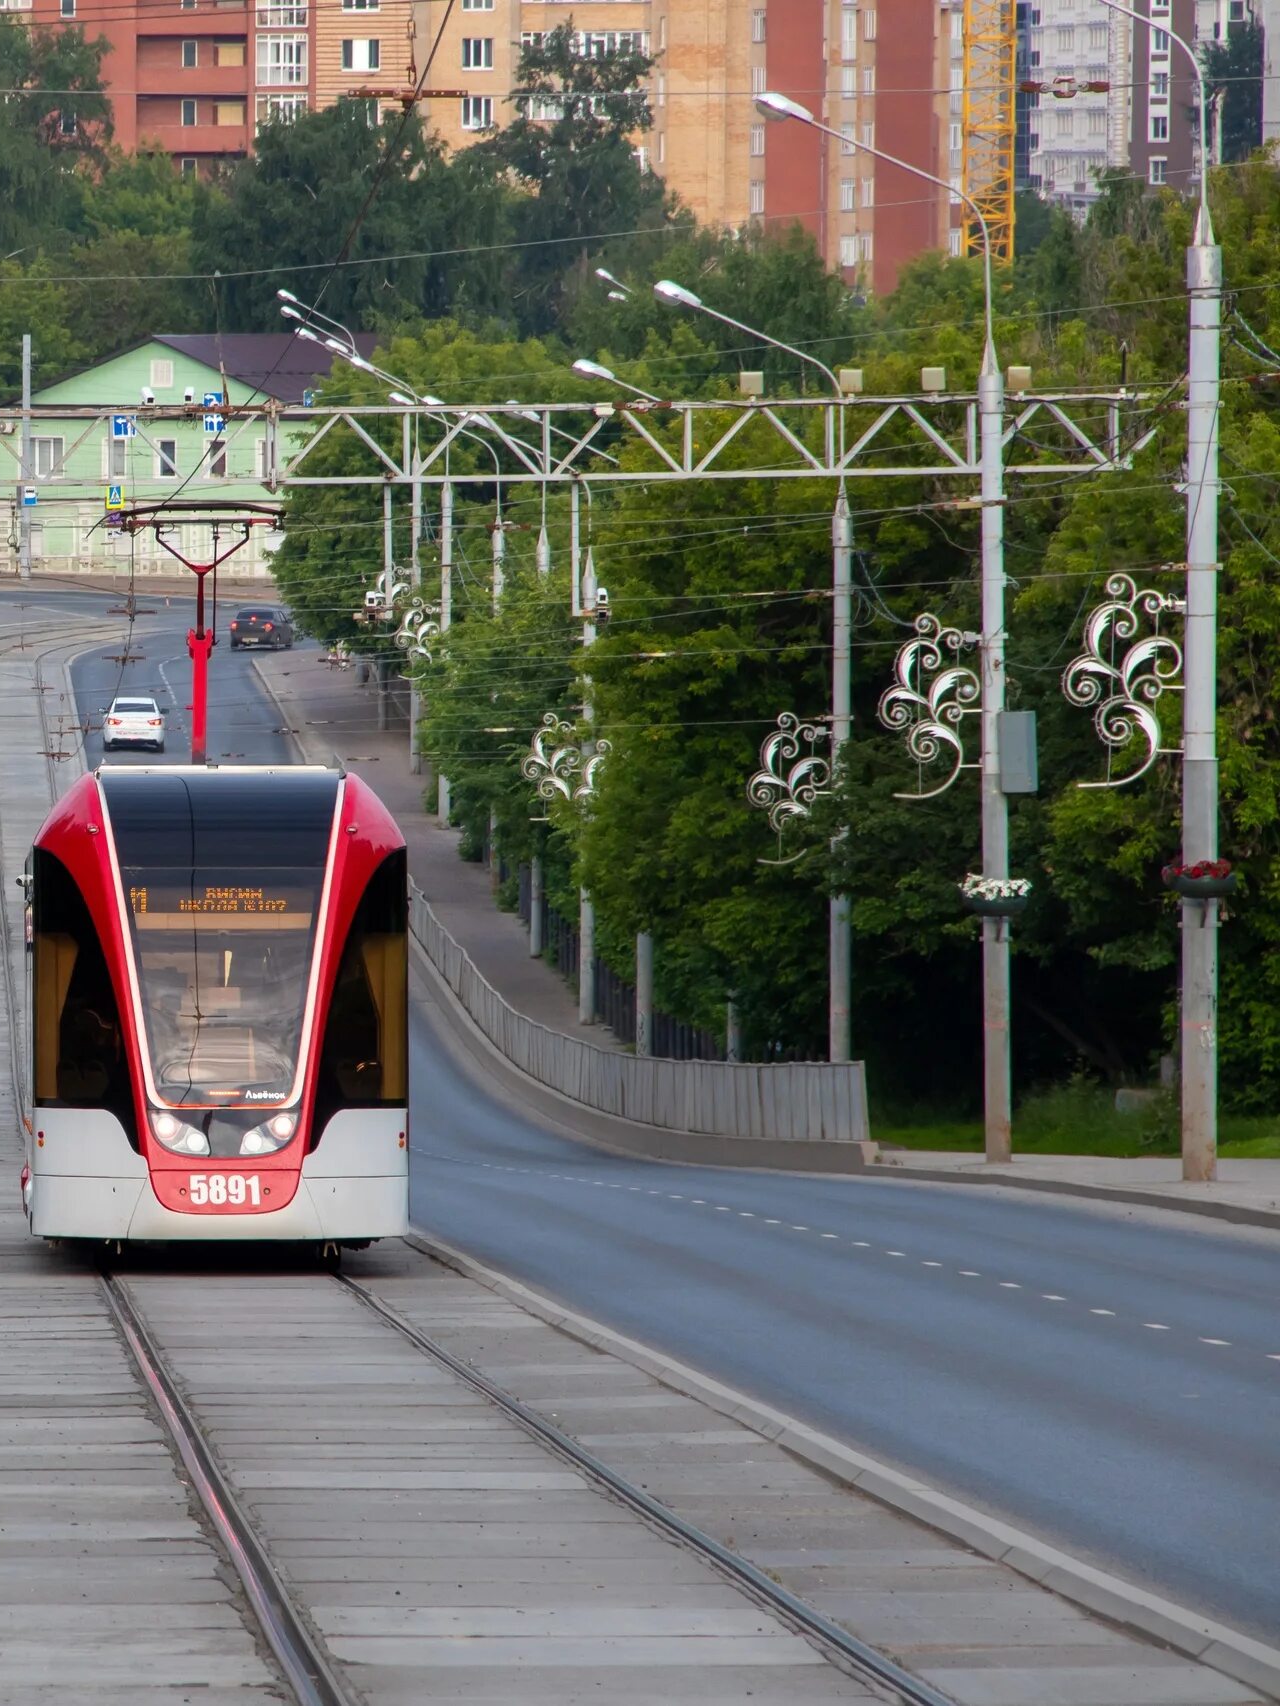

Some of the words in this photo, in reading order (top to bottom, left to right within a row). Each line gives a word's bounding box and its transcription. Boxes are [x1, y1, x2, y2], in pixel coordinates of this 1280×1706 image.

[130, 887, 147, 913] 11
[245, 1089, 286, 1099] Львёнок
[189, 1174, 261, 1205] 5891
